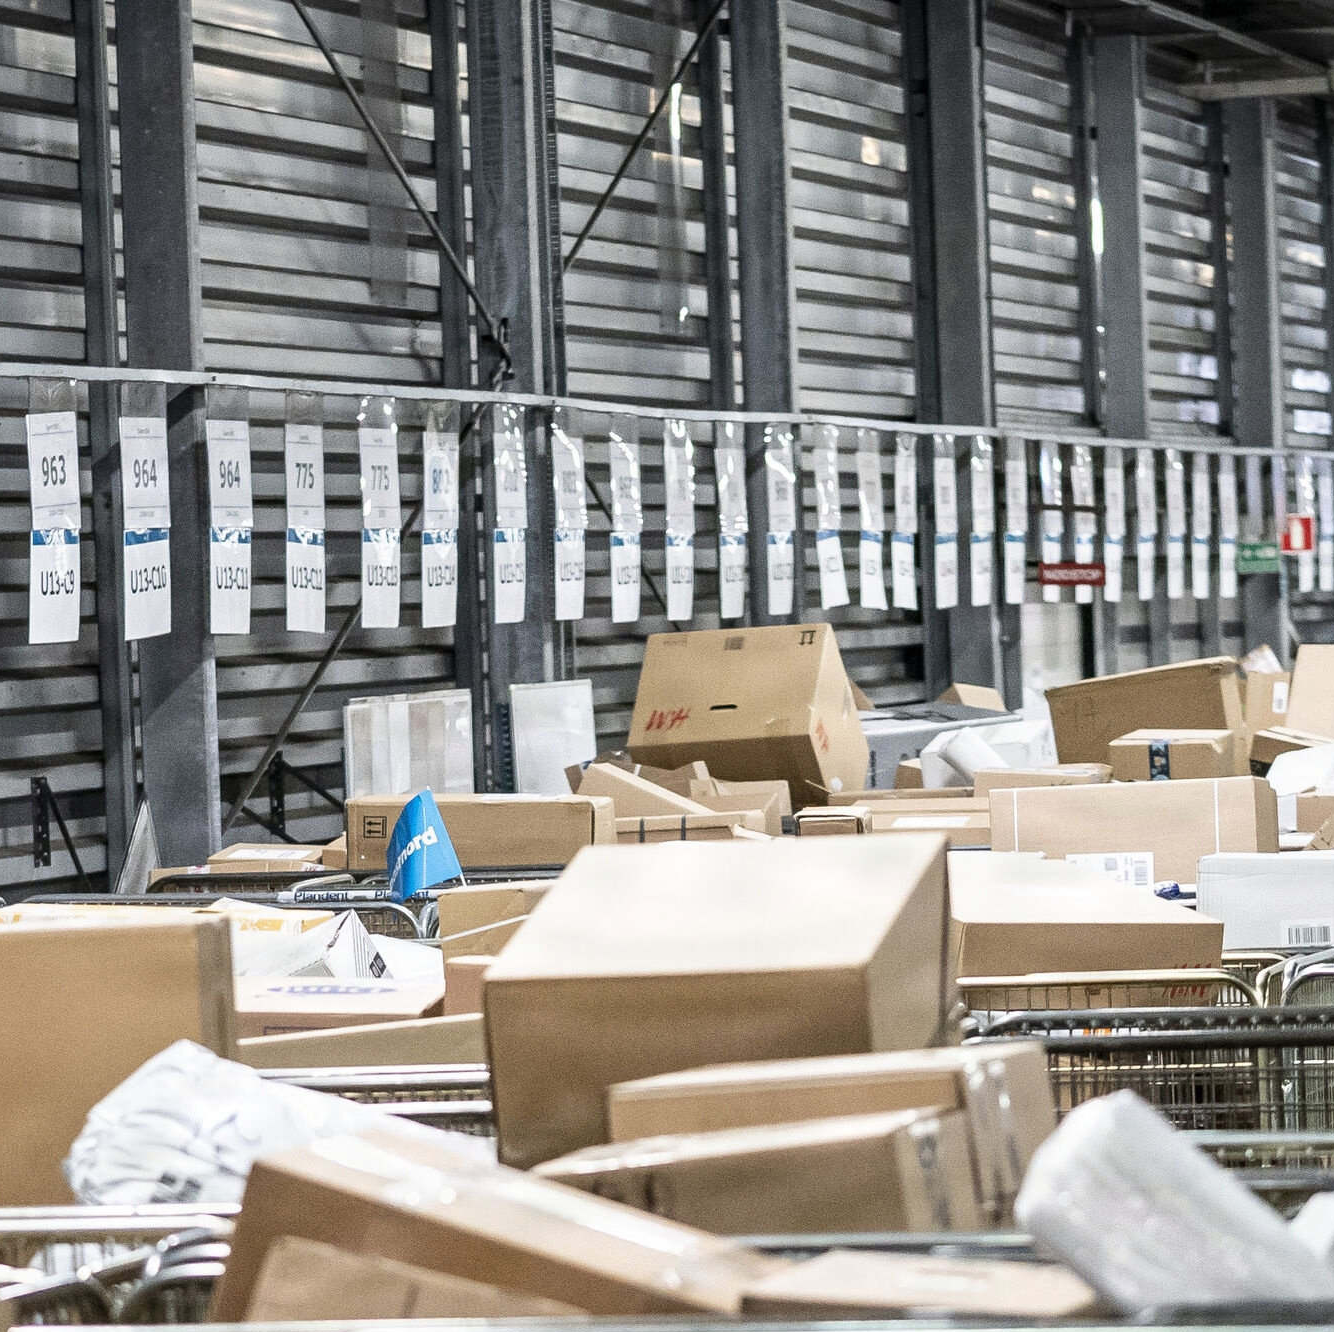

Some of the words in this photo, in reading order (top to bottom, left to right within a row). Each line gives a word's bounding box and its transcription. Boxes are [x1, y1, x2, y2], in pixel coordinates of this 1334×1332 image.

[42, 455, 66, 486] 963
[133, 459, 157, 488] 964
[219, 460, 241, 488] 964
[295, 463, 315, 489] 775
[371, 465, 389, 490] 775
[40, 569, 75, 596] U13-C9
[130, 564, 167, 594] U13-C10
[216, 566, 249, 590] U13-C11
[389, 826, 439, 892] nord
[294, 890, 348, 901] Plandent
[374, 889, 430, 900] Plent
